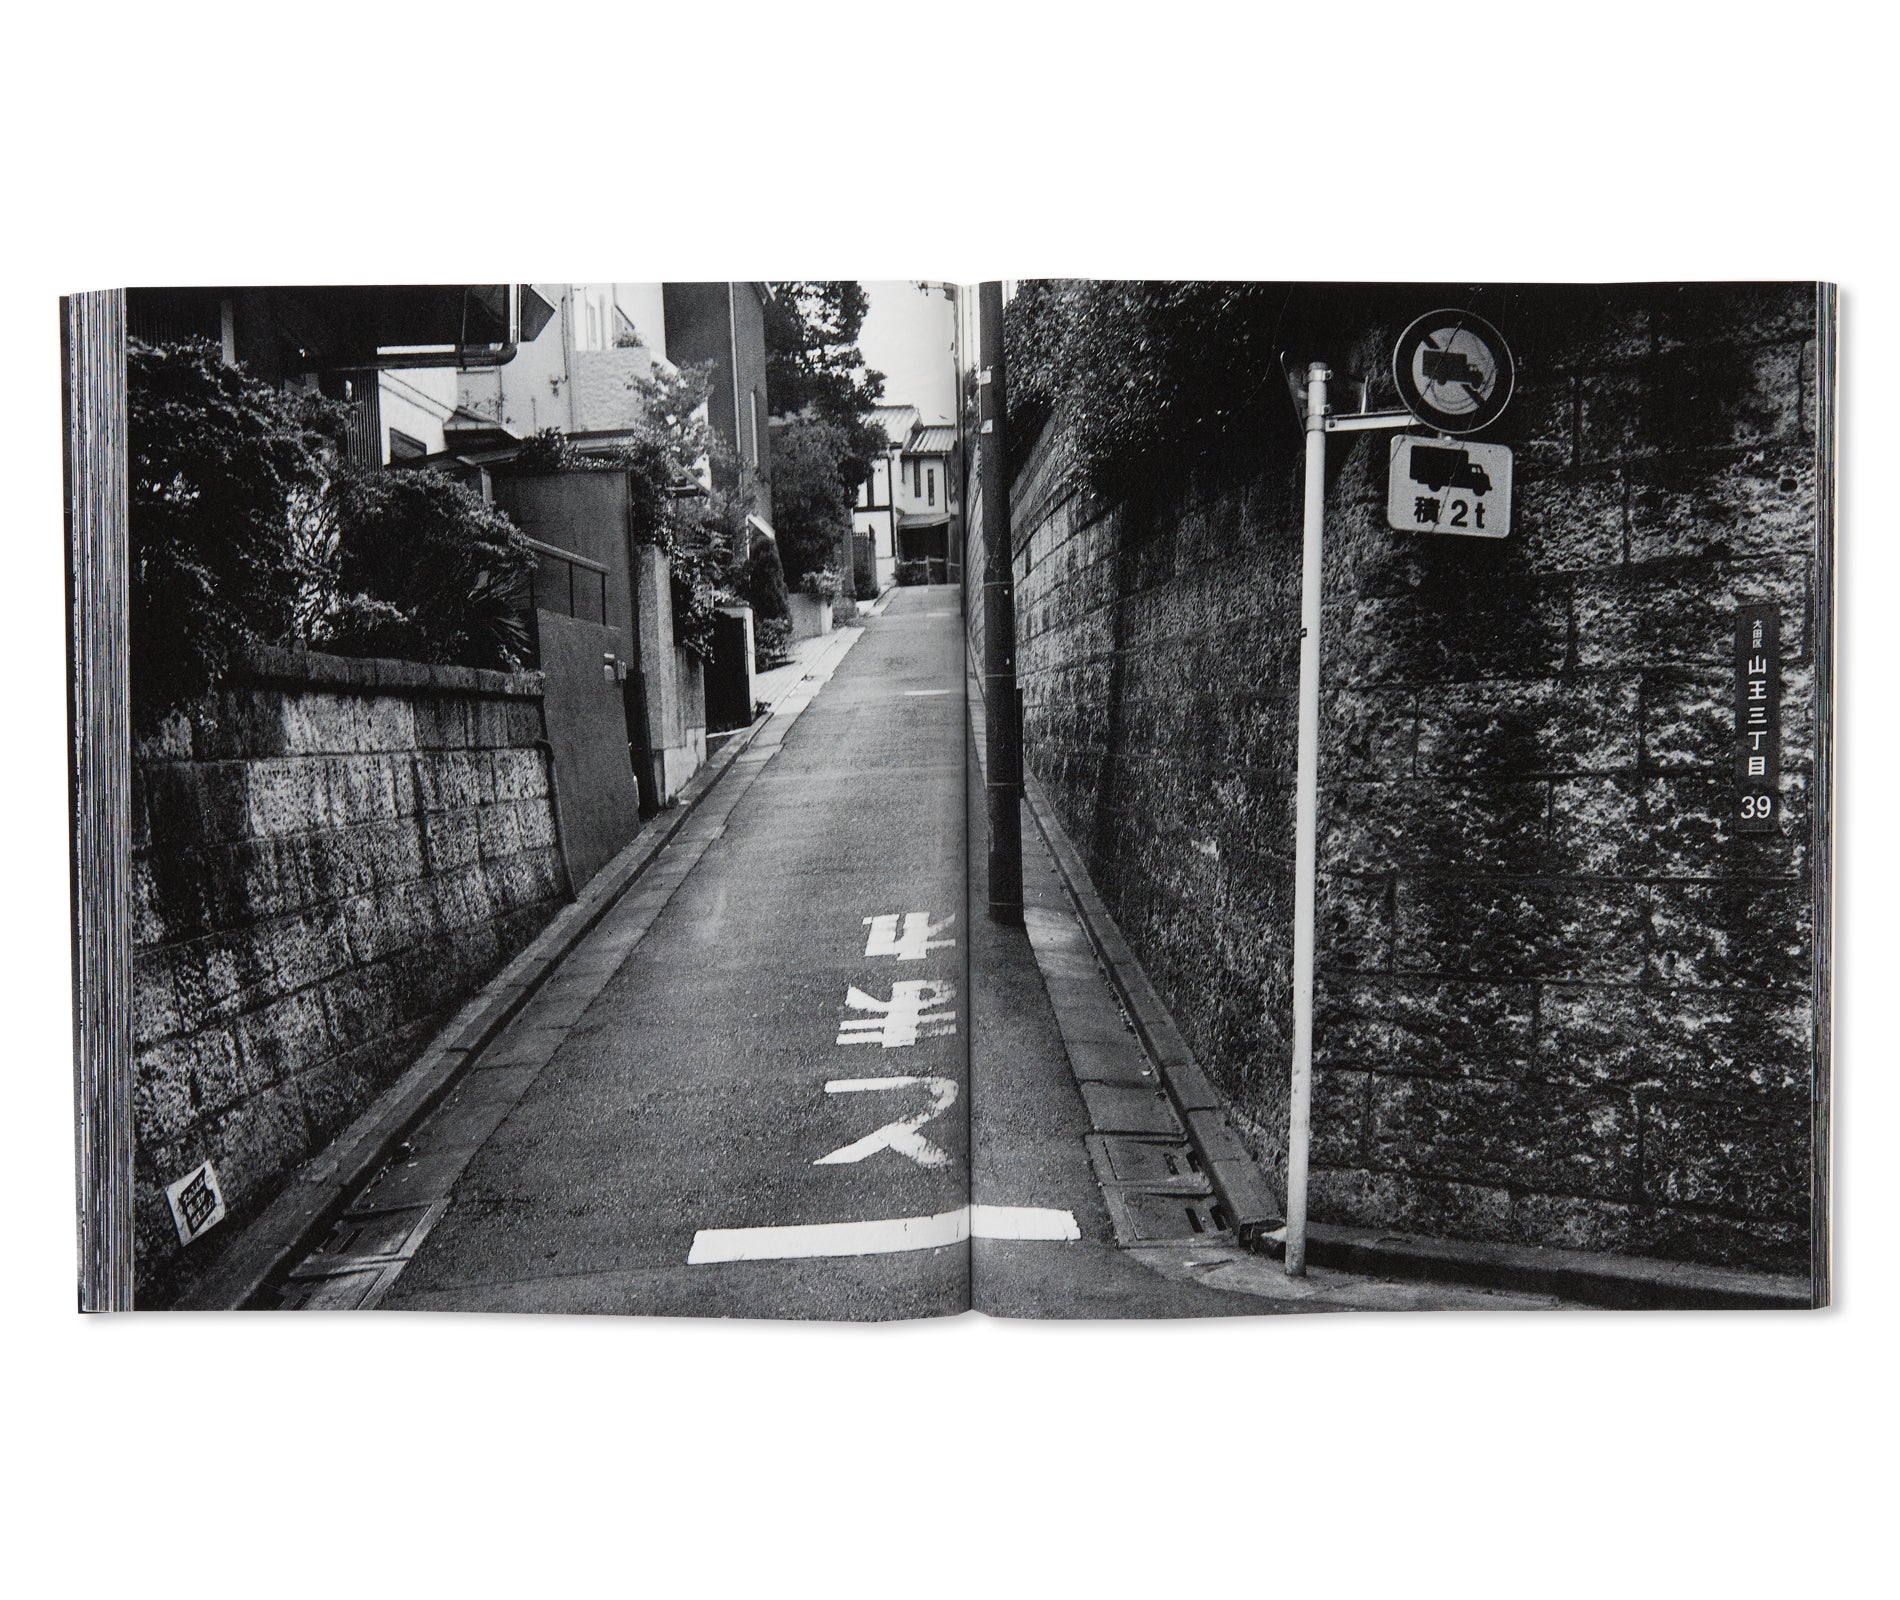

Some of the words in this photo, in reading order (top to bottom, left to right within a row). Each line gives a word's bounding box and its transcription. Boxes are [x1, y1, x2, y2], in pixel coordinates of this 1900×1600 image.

[1752, 618, 1763, 649] 大田区
[1747, 655, 1768, 777] 山王三丁目
[1740, 795, 1772, 819] 39
